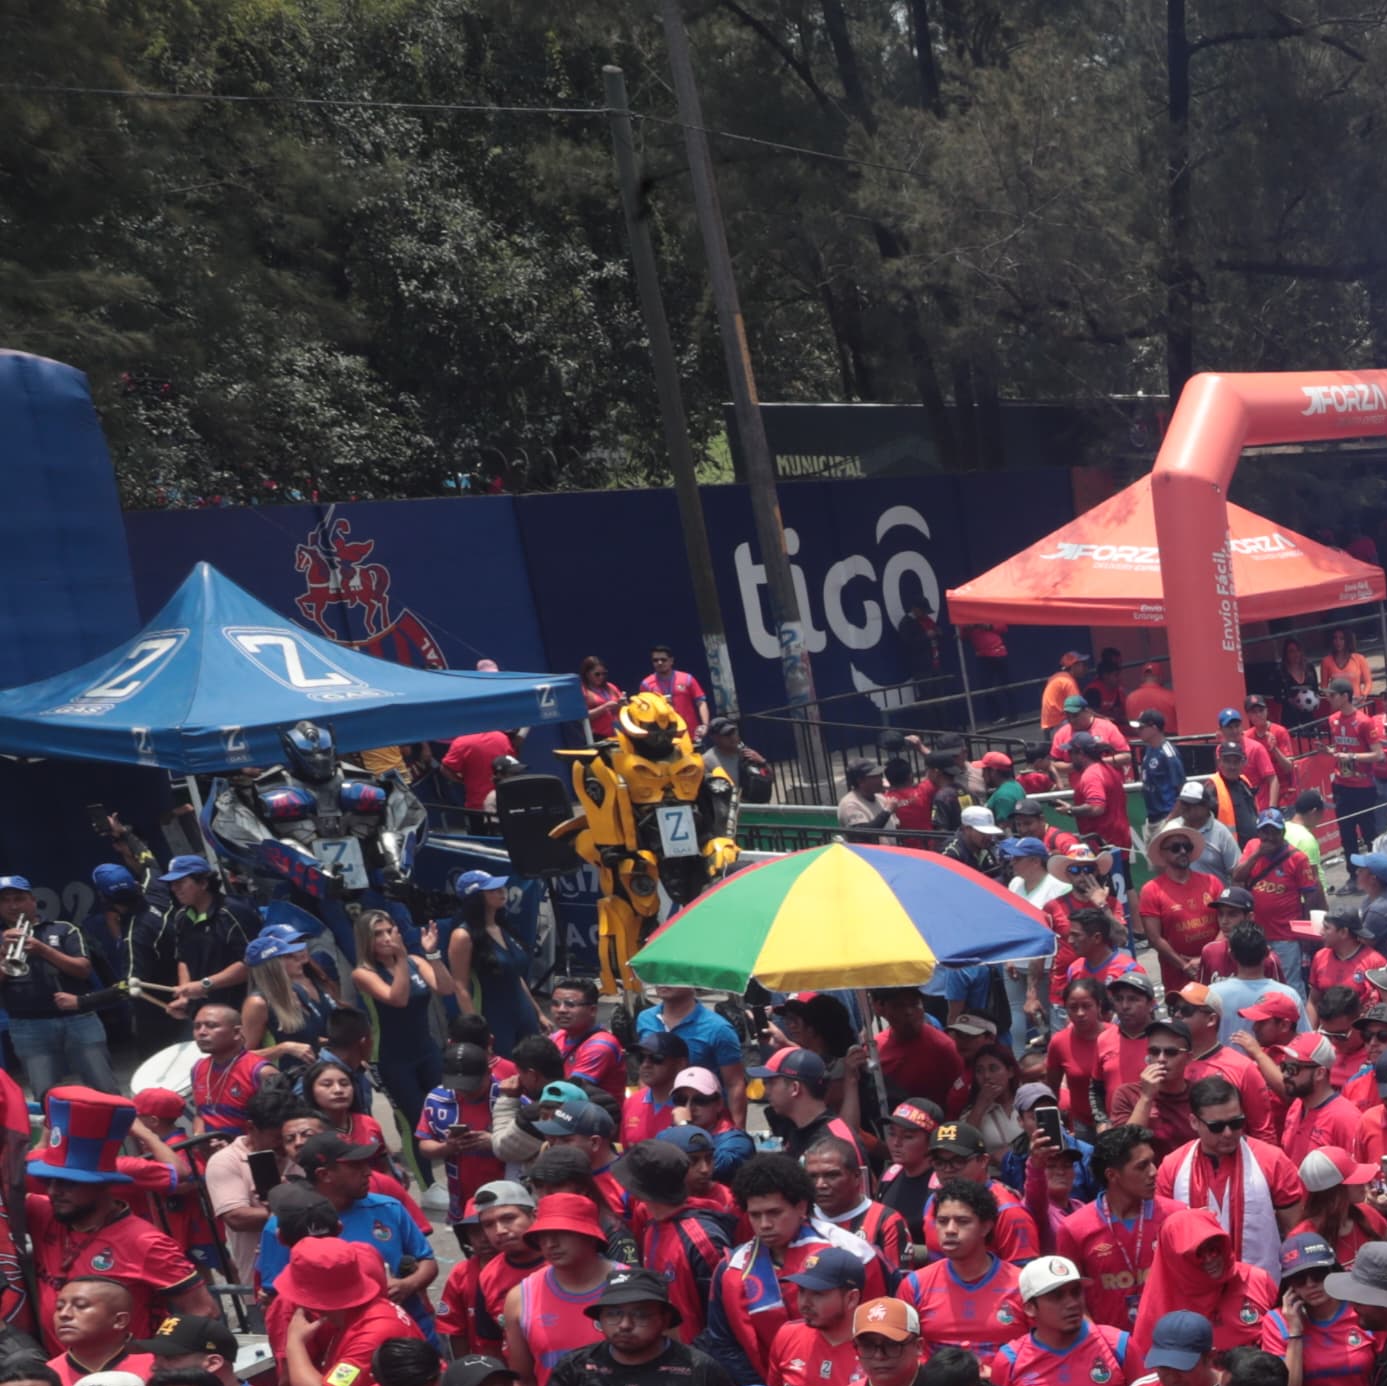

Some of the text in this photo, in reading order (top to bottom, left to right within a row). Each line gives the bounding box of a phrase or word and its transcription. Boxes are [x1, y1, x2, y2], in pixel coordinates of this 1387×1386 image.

[776, 454, 867, 478] MUNICIPAL
[85, 637, 178, 698] Z
[235, 633, 352, 688] Z
[665, 811, 689, 842] Z
